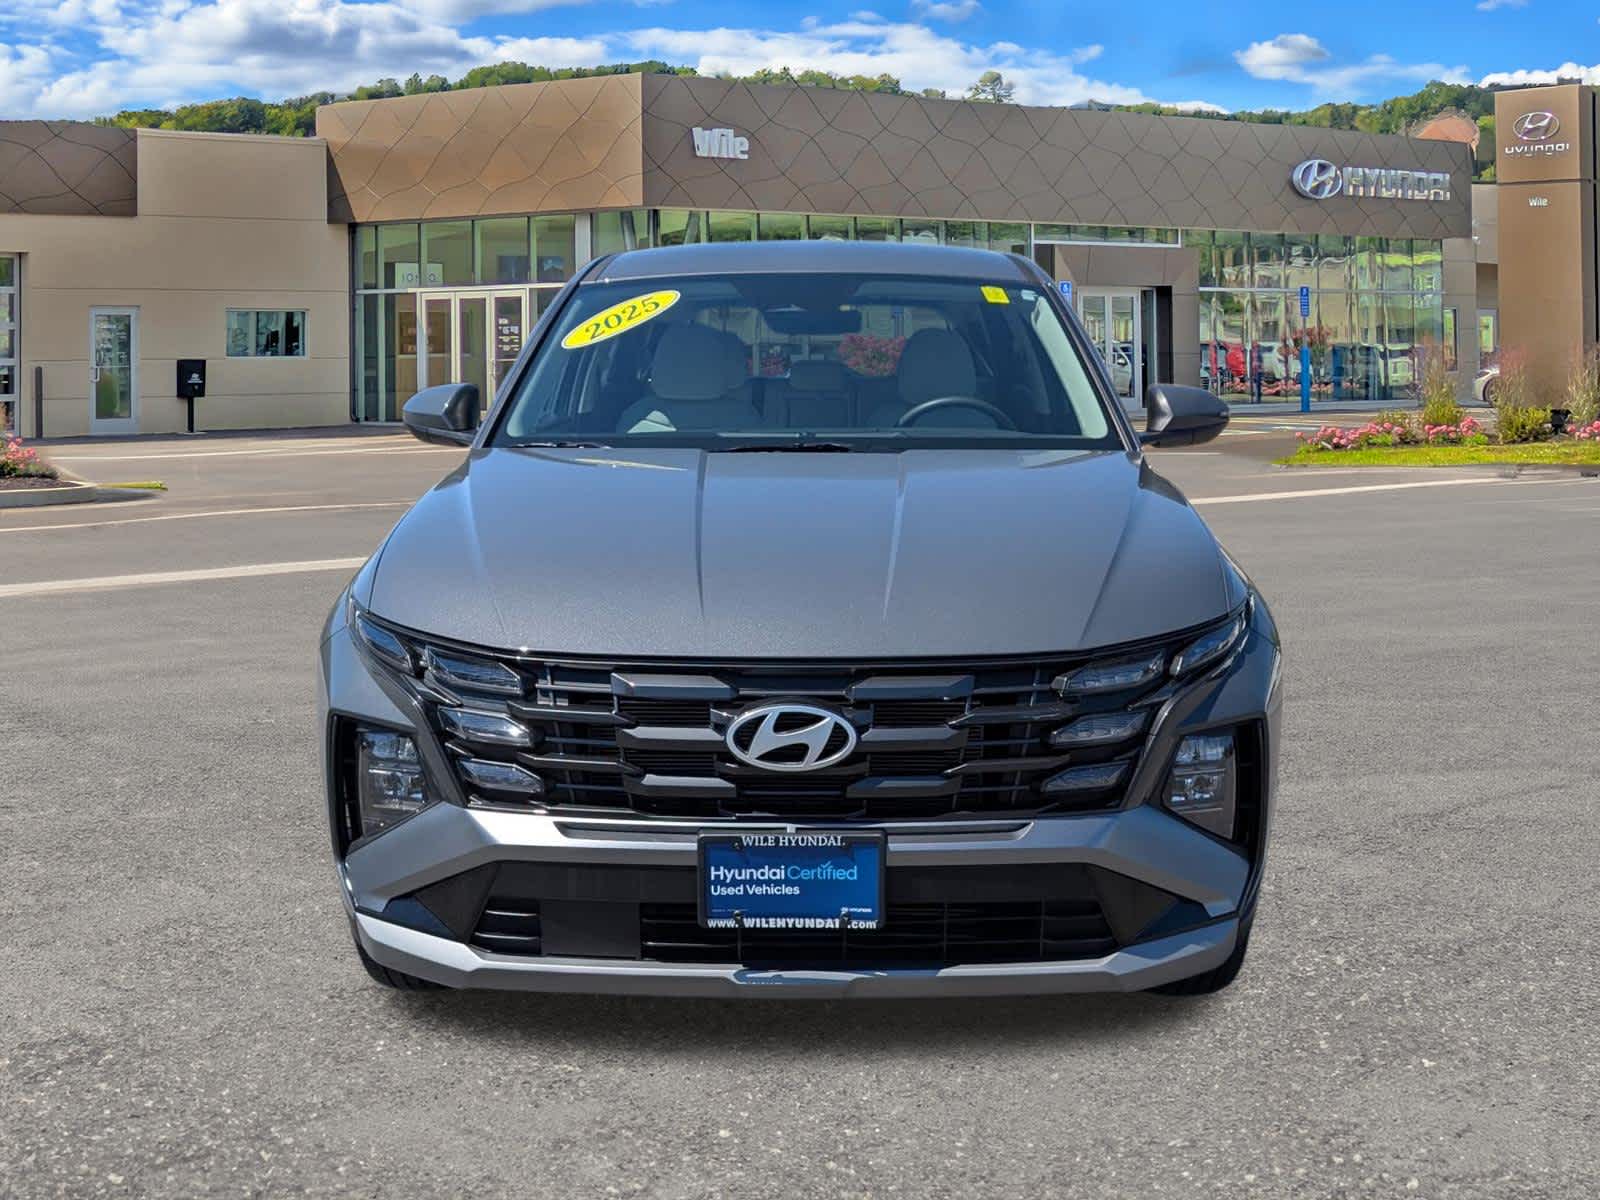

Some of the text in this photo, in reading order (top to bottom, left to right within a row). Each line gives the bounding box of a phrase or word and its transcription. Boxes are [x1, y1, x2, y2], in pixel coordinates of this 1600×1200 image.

[692, 127, 749, 159] Wile
[1343, 167, 1450, 201] HYUNDAI
[585, 296, 661, 340] 2025
[741, 835, 779, 847] WILE
[710, 861, 857, 883] Hyundai Certified
[711, 883, 800, 895] Used Vehicles
